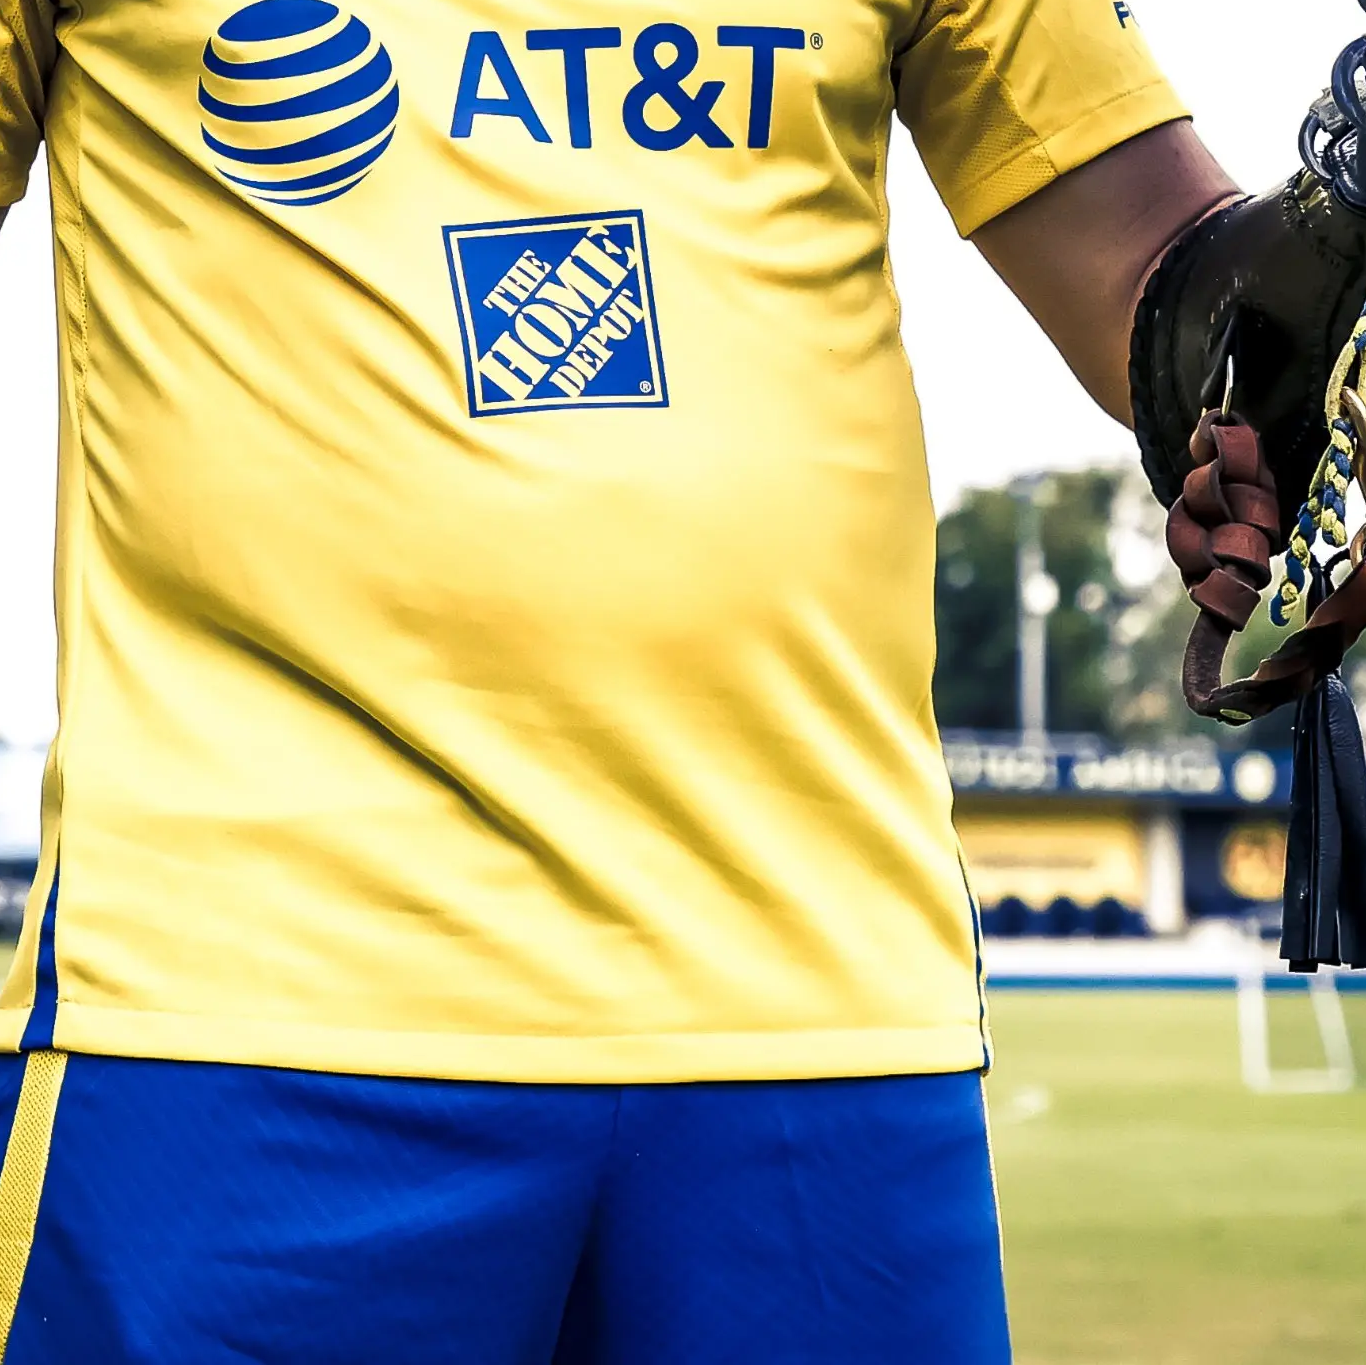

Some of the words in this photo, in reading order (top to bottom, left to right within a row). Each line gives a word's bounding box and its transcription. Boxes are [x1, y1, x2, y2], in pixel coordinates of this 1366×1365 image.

[478, 225, 638, 401] HOME
[483, 249, 552, 317] THE
[549, 288, 644, 398] DEPOT
